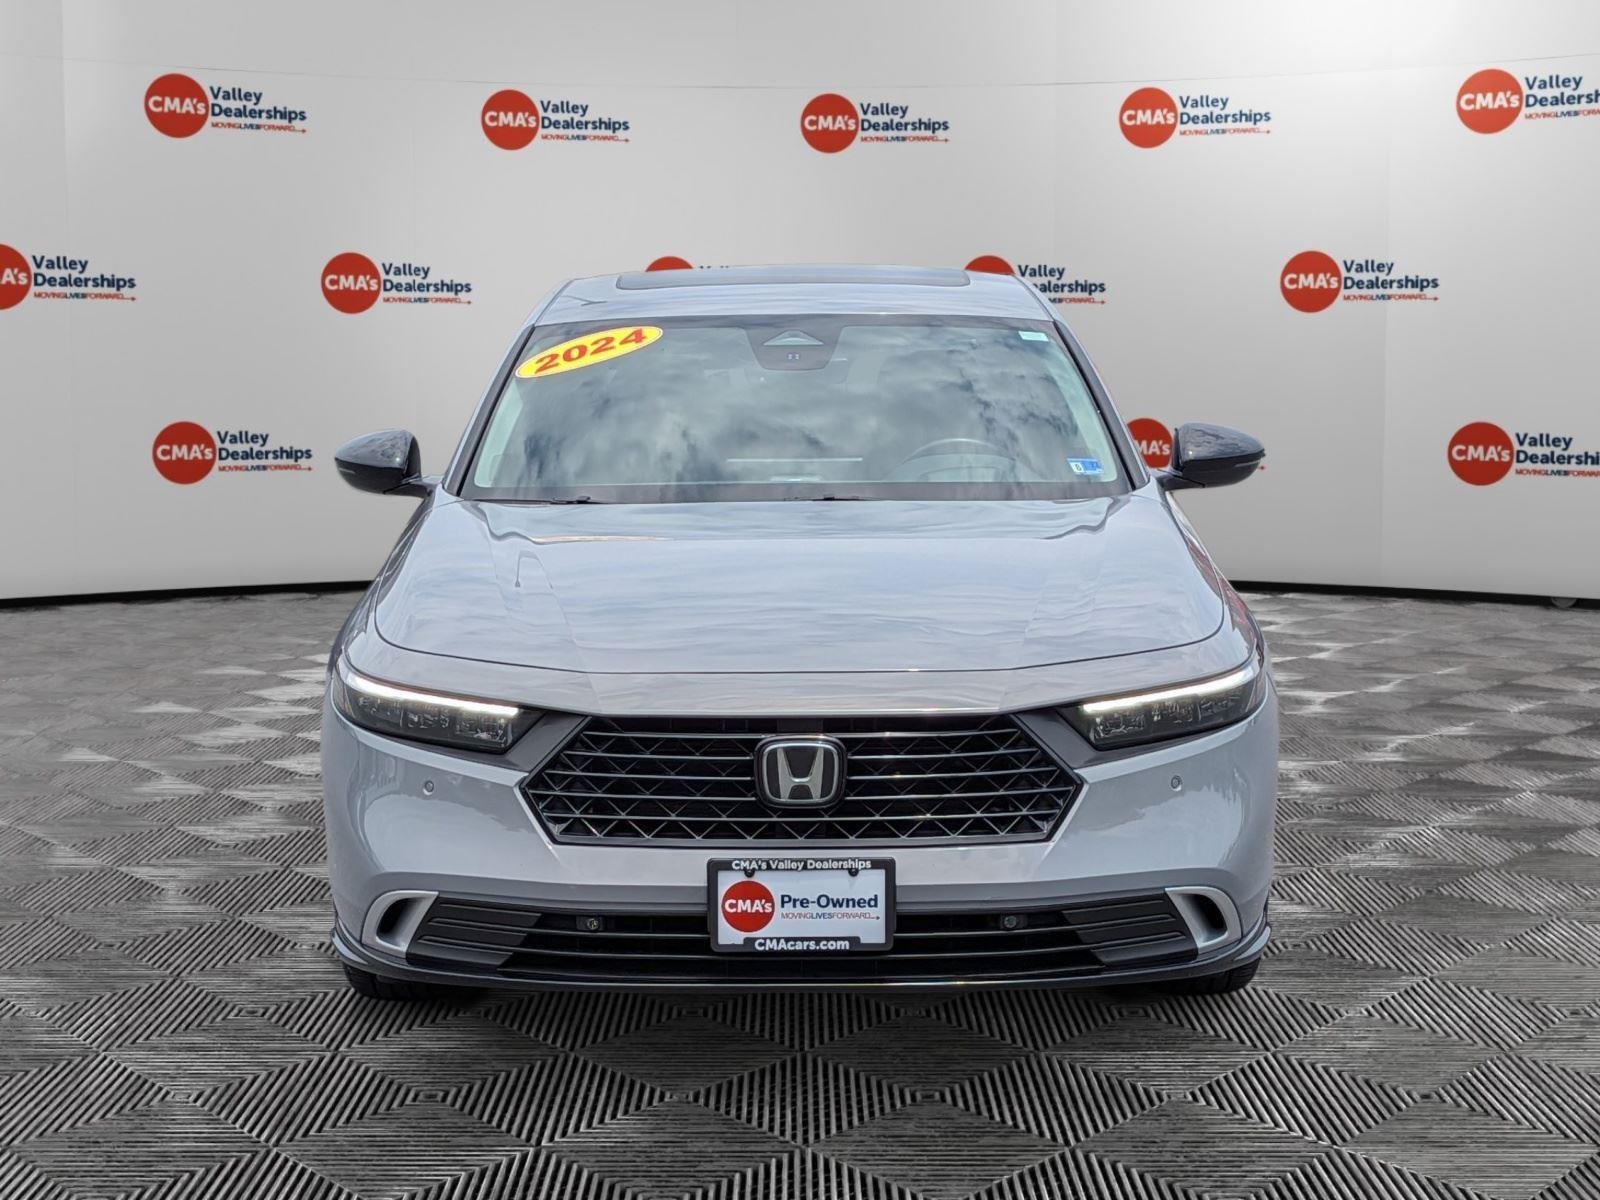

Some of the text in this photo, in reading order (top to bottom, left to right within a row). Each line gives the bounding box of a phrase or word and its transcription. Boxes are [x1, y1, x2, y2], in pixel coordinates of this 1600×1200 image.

[1525, 74, 1583, 91] Valley
[210, 86, 263, 105] Valley
[1180, 95, 1229, 111] Valley
[1460, 90, 1520, 111] CMA's
[148, 96, 206, 115] CMA's
[211, 103, 307, 123] Dealerships
[540, 100, 589, 117] Valley
[860, 103, 908, 119] Valley
[484, 111, 537, 128] CMA's
[541, 116, 630, 133] Dealerships
[804, 115, 857, 131] CMA's
[1122, 108, 1175, 126] CMA's
[1180, 109, 1271, 125] Dealerships
[860, 118, 950, 134] Dealerships
[32, 255, 88, 274] Valley
[382, 263, 430, 279] Valley
[1018, 264, 1066, 280] Valley
[1343, 260, 1394, 276] Valley
[0, 268, 28, 285] A's
[33, 272, 136, 291] Dealerships
[324, 274, 379, 291] CMA's
[1284, 272, 1339, 290] CMA's
[1343, 275, 1439, 291] Dealerships
[383, 279, 472, 295] Dealerships
[1033, 279, 1106, 296] alerships
[534, 328, 647, 374] 2024
[217, 430, 269, 446] Valley
[1515, 432, 1573, 450] Valley
[156, 443, 213, 461] CMA's
[218, 446, 312, 462] Dealerships
[1134, 439, 1170, 455] MA's
[1452, 444, 1511, 462] CMA's
[731, 859, 872, 871] CMA's Valley Dealerships
[724, 899, 773, 914] CMA's
[780, 894, 878, 909] Pre-Owned
[754, 939, 850, 951] CMAcars.com
